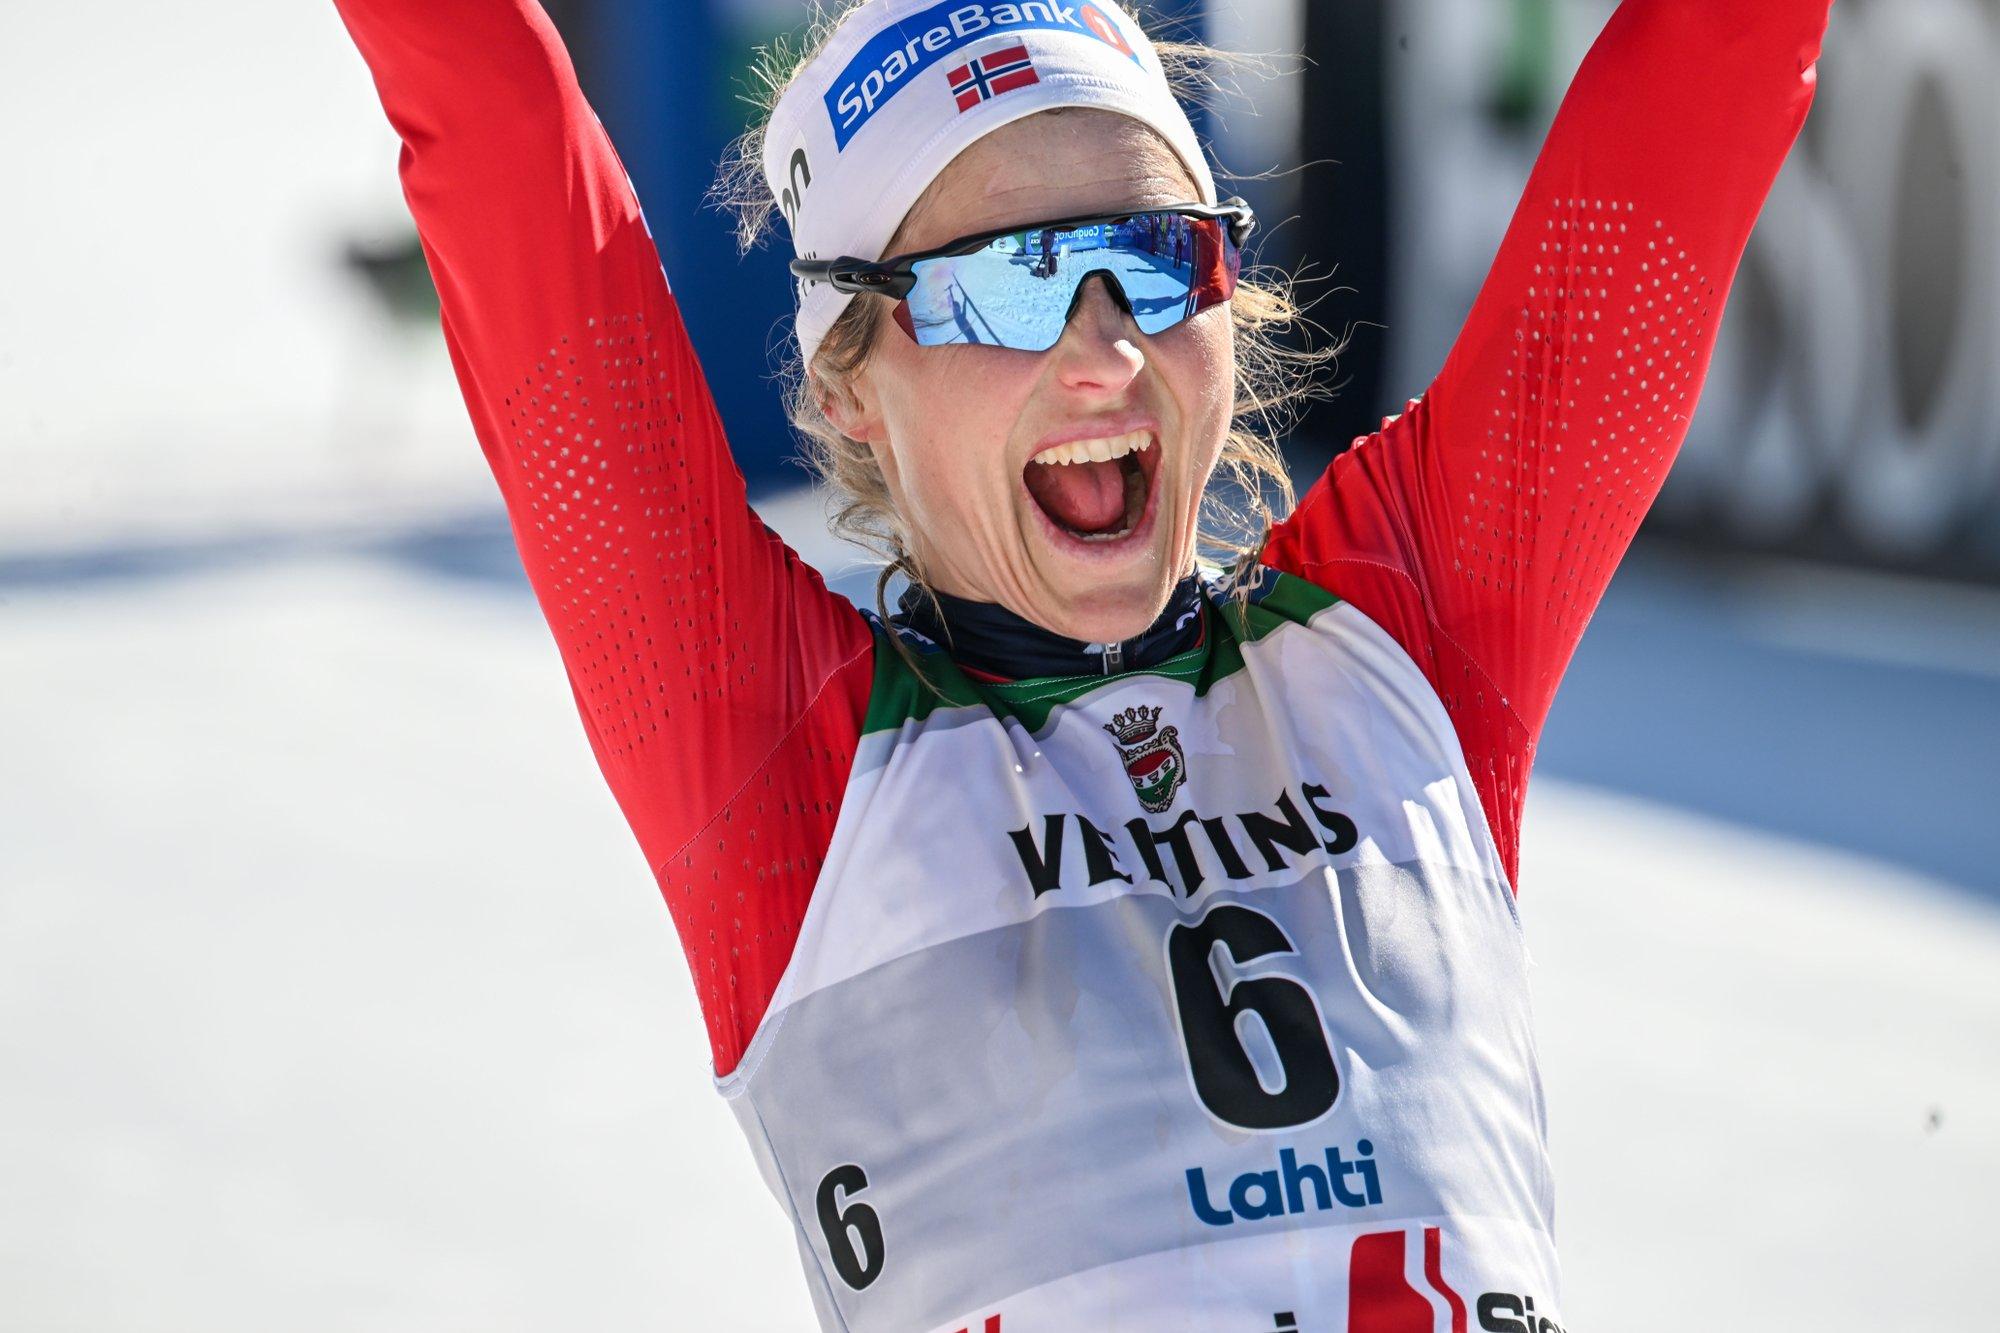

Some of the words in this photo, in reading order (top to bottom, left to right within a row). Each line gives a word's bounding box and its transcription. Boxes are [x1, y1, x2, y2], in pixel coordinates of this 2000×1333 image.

[836, 2, 1082, 130] SpareBank
[1169, 903, 1341, 1131] 6
[815, 1163, 886, 1291] 6
[1185, 1139, 1384, 1226] Lahti
